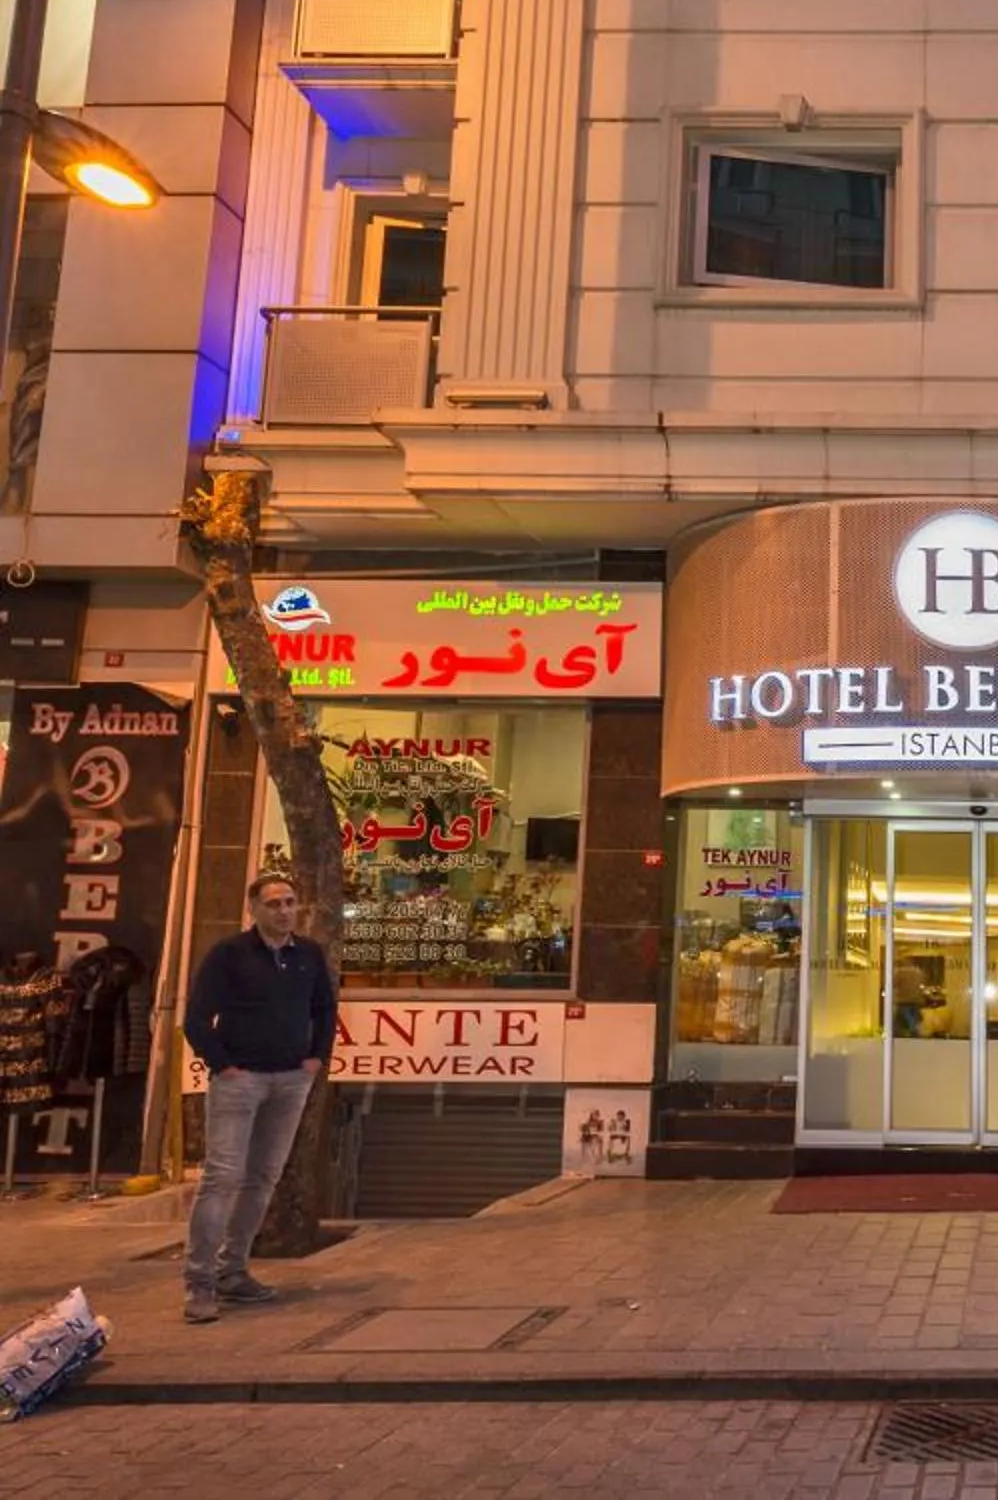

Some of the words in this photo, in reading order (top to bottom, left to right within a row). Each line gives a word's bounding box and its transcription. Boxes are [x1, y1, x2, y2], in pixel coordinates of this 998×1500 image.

[267, 634, 356, 662] NUR
[381, 627, 527, 688] نور
[709, 666, 902, 722] HOTEL
[30, 703, 74, 742] By
[79, 704, 179, 737] Adnan
[347, 738, 492, 759] AYNUR
[702, 848, 731, 863] TEK
[736, 850, 792, 867] AYNUR
[334, 1009, 540, 1047] ANTE
[328, 1056, 536, 1076] DERWEAR
